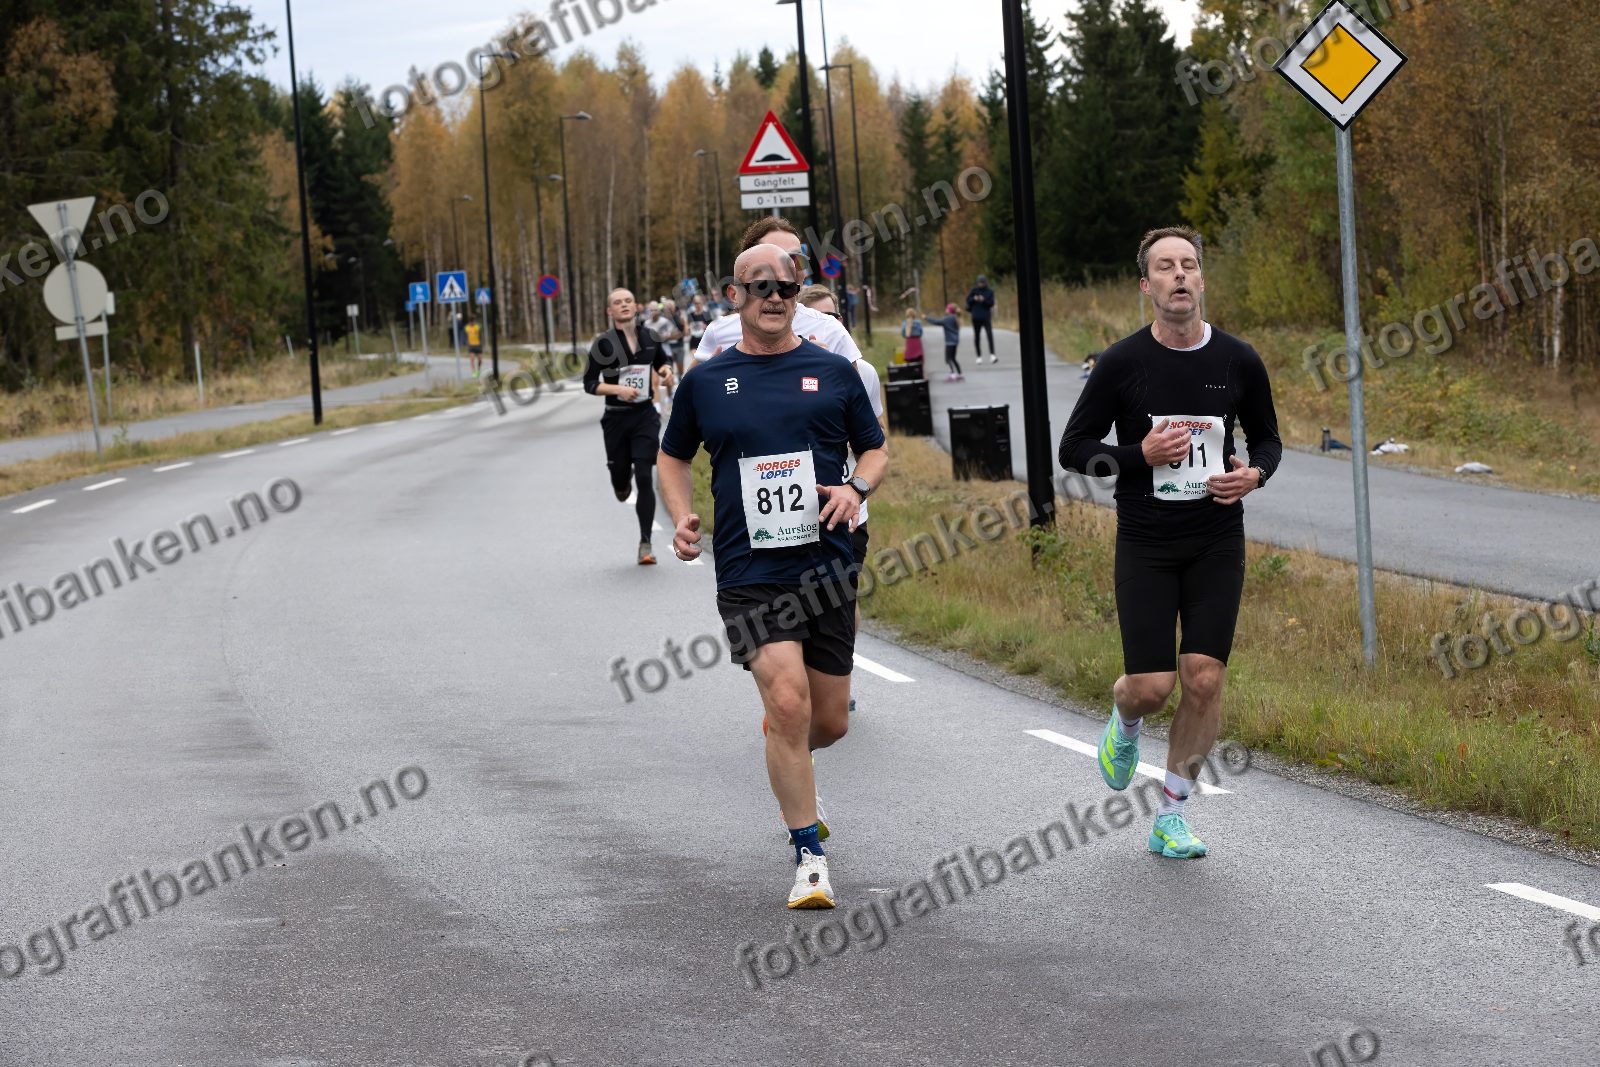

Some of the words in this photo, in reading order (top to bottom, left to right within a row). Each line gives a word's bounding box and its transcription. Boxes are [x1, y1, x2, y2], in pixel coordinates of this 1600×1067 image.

[754, 175, 795, 188] Gangfelt
[780, 195, 794, 204] km
[625, 378, 644, 389] 353
[1169, 421, 1213, 430] NORGES
[1168, 442, 1207, 470] 11
[755, 458, 801, 472] NORGES
[760, 468, 795, 480] LØPET
[1183, 480, 1207, 489] Aurs
[756, 484, 805, 515] 812
[777, 523, 818, 536] Aurskog
